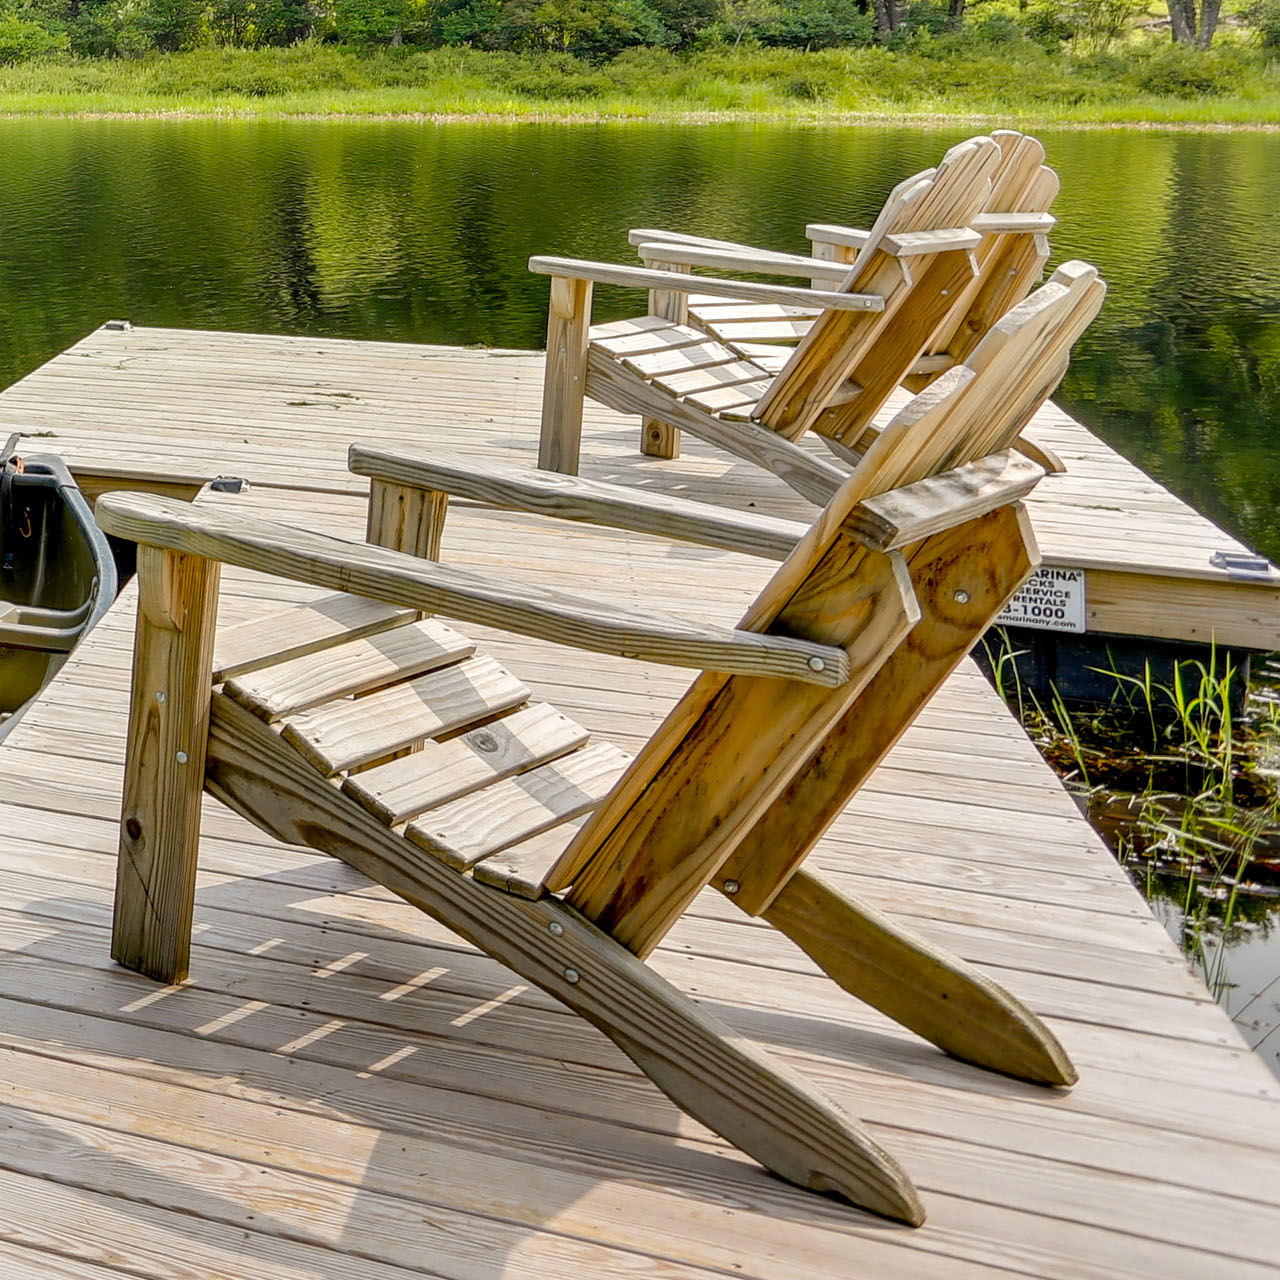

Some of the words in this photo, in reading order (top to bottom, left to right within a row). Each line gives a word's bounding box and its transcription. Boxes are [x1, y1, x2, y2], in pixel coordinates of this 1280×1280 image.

[1024, 578, 1055, 588] CKS
[1018, 587, 1071, 599] SERVICE
[1013, 595, 1066, 607] RENTALS
